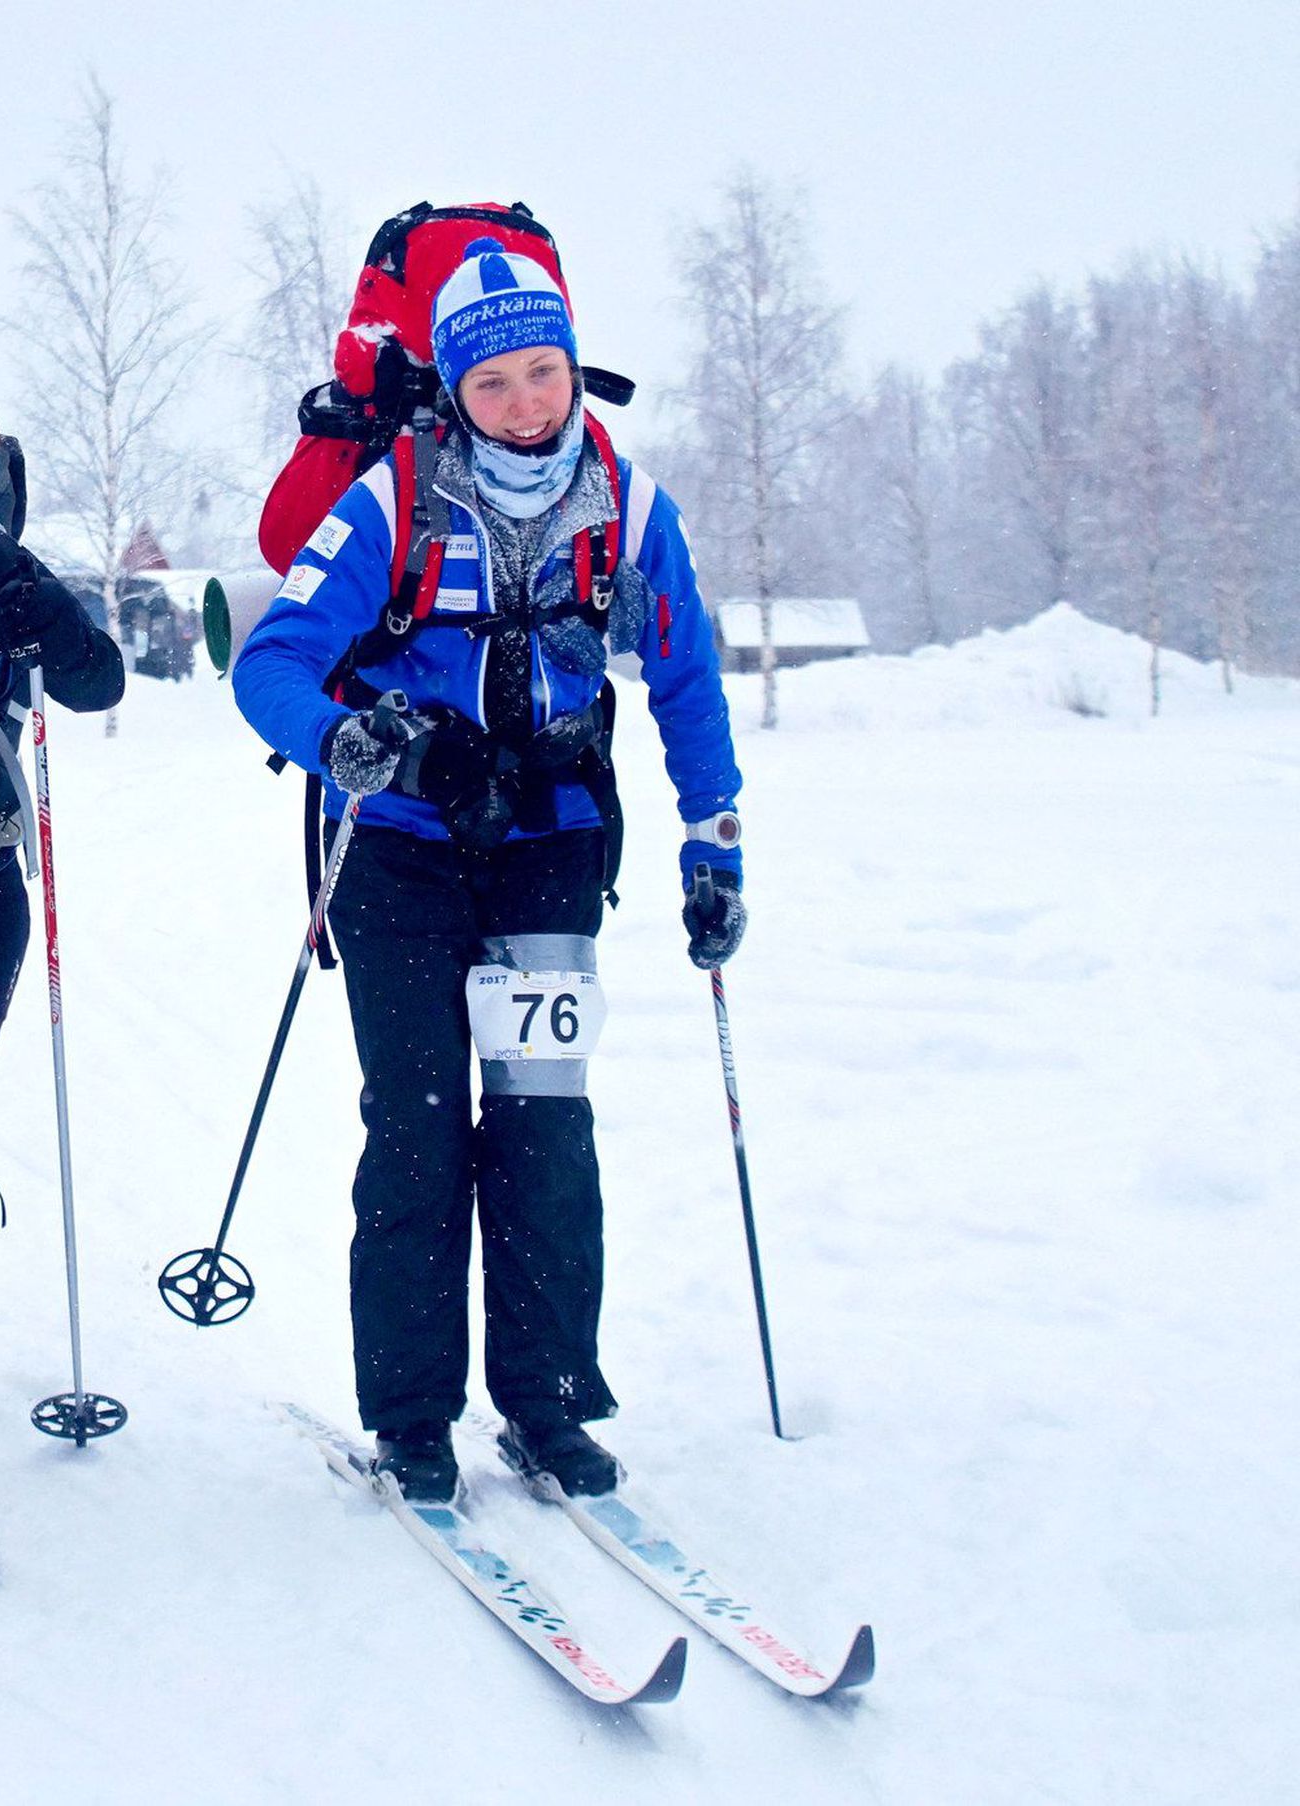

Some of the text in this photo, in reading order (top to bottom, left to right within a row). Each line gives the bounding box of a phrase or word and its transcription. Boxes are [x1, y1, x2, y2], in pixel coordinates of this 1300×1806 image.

[513, 325, 545, 336] 2017
[479, 975, 508, 985] 2017
[512, 993, 579, 1044] 76
